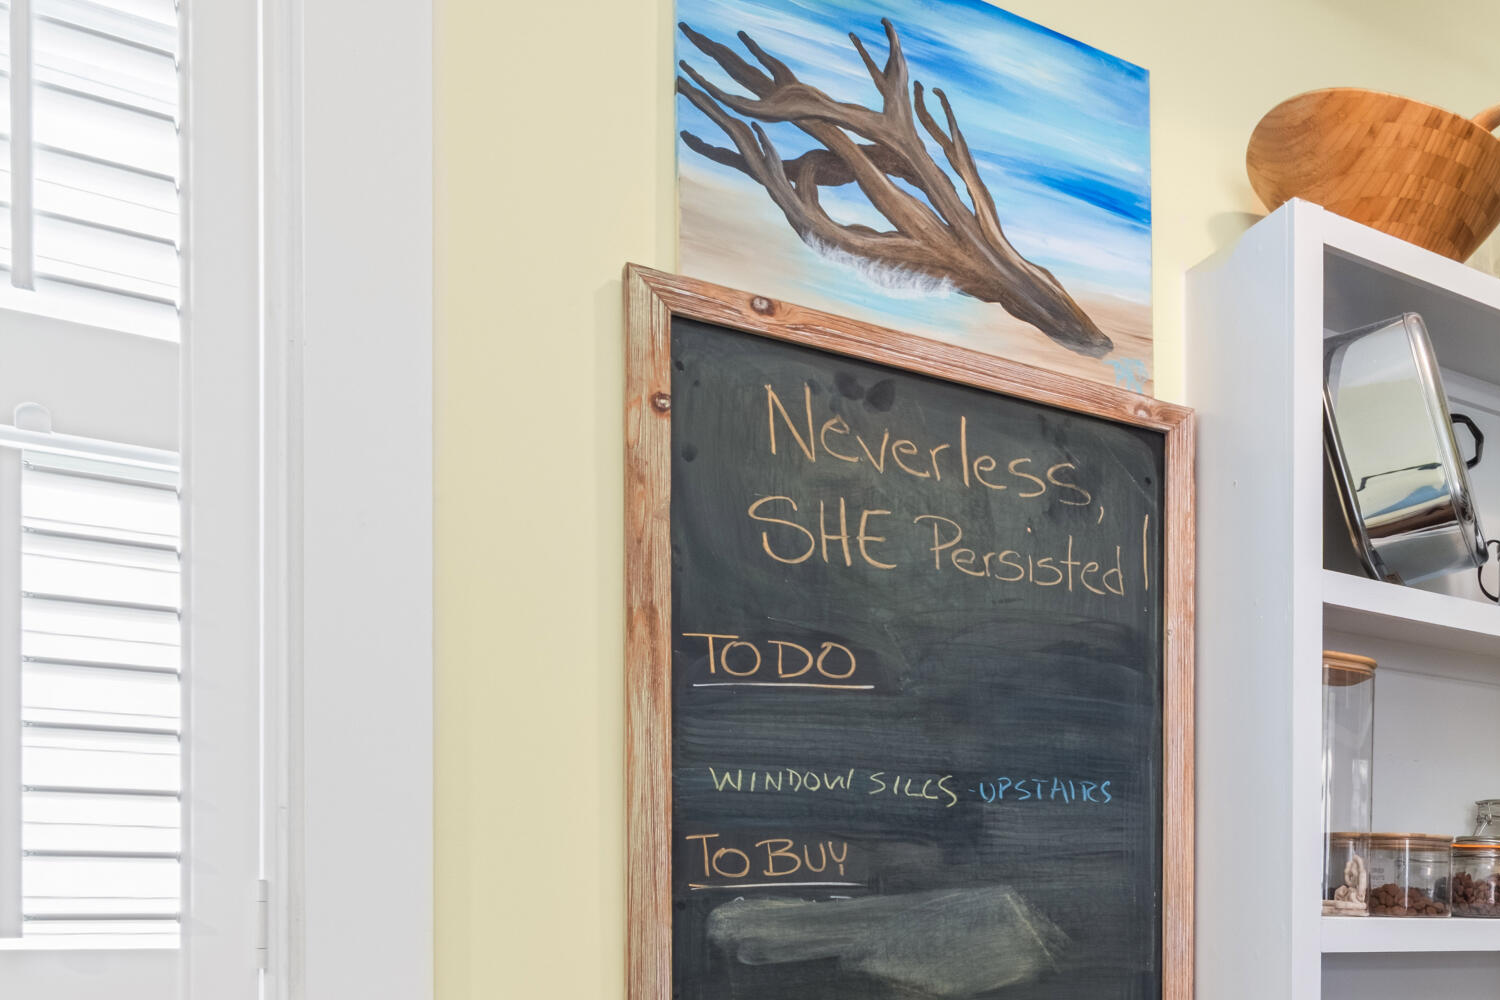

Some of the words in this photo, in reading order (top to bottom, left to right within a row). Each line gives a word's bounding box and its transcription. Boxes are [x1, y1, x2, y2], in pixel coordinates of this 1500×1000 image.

[748, 496, 897, 570] SHE
[709, 766, 854, 792] WINDOW
[755, 838, 847, 877] BUY
